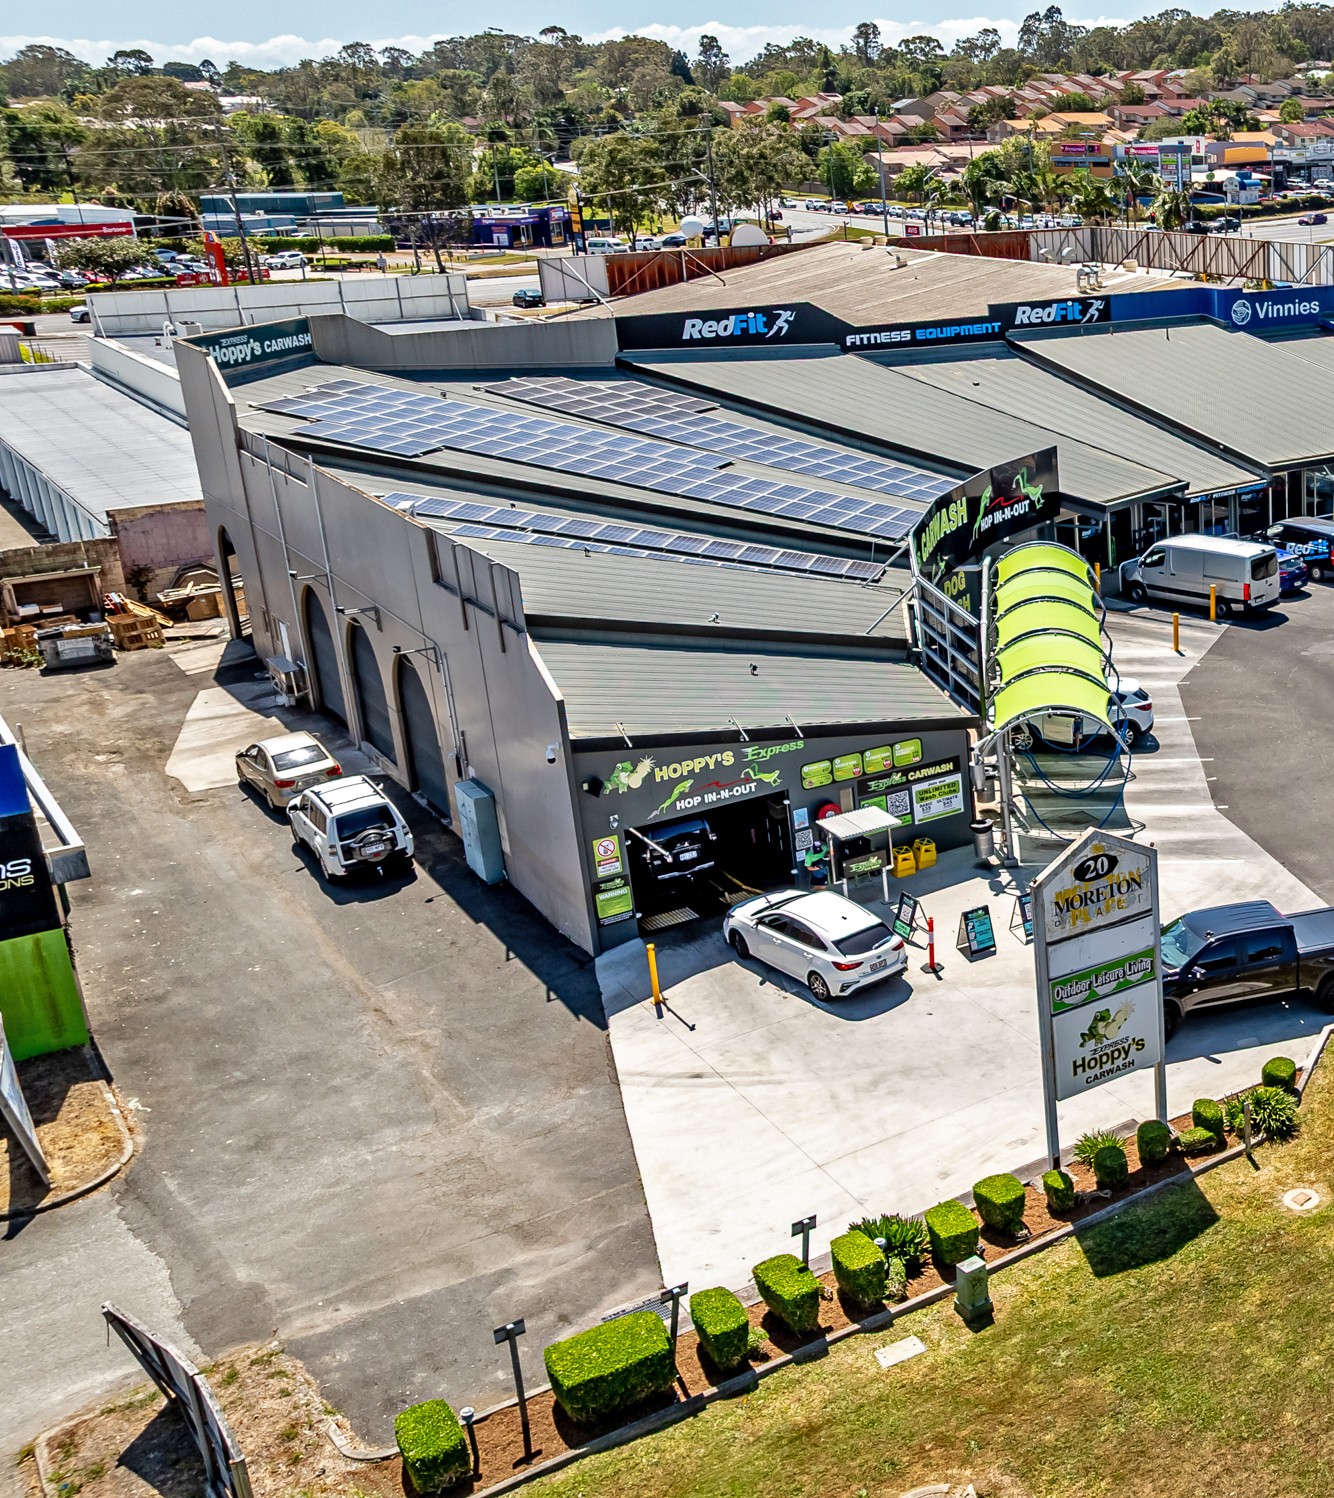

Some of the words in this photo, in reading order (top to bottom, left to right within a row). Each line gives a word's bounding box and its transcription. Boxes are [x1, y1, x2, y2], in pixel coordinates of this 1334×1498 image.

[1014, 301, 1083, 325] RedFit
[1255, 299, 1320, 319] Vinnies
[682, 312, 769, 340] RedFit
[846, 330, 911, 346] FITNESS
[915, 322, 1001, 340] EQUIPMENT
[209, 338, 262, 365] Hoppy's
[264, 332, 312, 353] CARWASH
[220, 335, 248, 347] EXPRESS
[1212, 489, 1236, 499] FITNESS
[921, 496, 968, 562] CARWASH
[980, 514, 993, 532] HOP
[993, 500, 1030, 525] IN-N-OUT
[1286, 538, 1329, 555] RedFit
[943, 570, 966, 598] DOG
[654, 751, 735, 782] HOPPY'S
[741, 740, 805, 762] Express
[867, 774, 907, 792] Express
[908, 762, 954, 780] CARWASH
[918, 782, 957, 796] UNLIMITED
[676, 796, 702, 811] HOP
[704, 782, 758, 804] IN-N-OUT
[919, 793, 937, 802] Wash
[938, 788, 957, 797] Clubs
[1084, 856, 1109, 879] 20
[598, 888, 628, 900] WARNING
[1053, 874, 1143, 917] MORETON
[1054, 979, 1091, 1002] Outdoor
[1091, 966, 1124, 988] Leisure
[1125, 959, 1153, 976] Living
[1072, 1037, 1145, 1077] Hoppy's
[1089, 1035, 1130, 1056] EXPRESS
[1085, 1059, 1135, 1085] CARWASH
